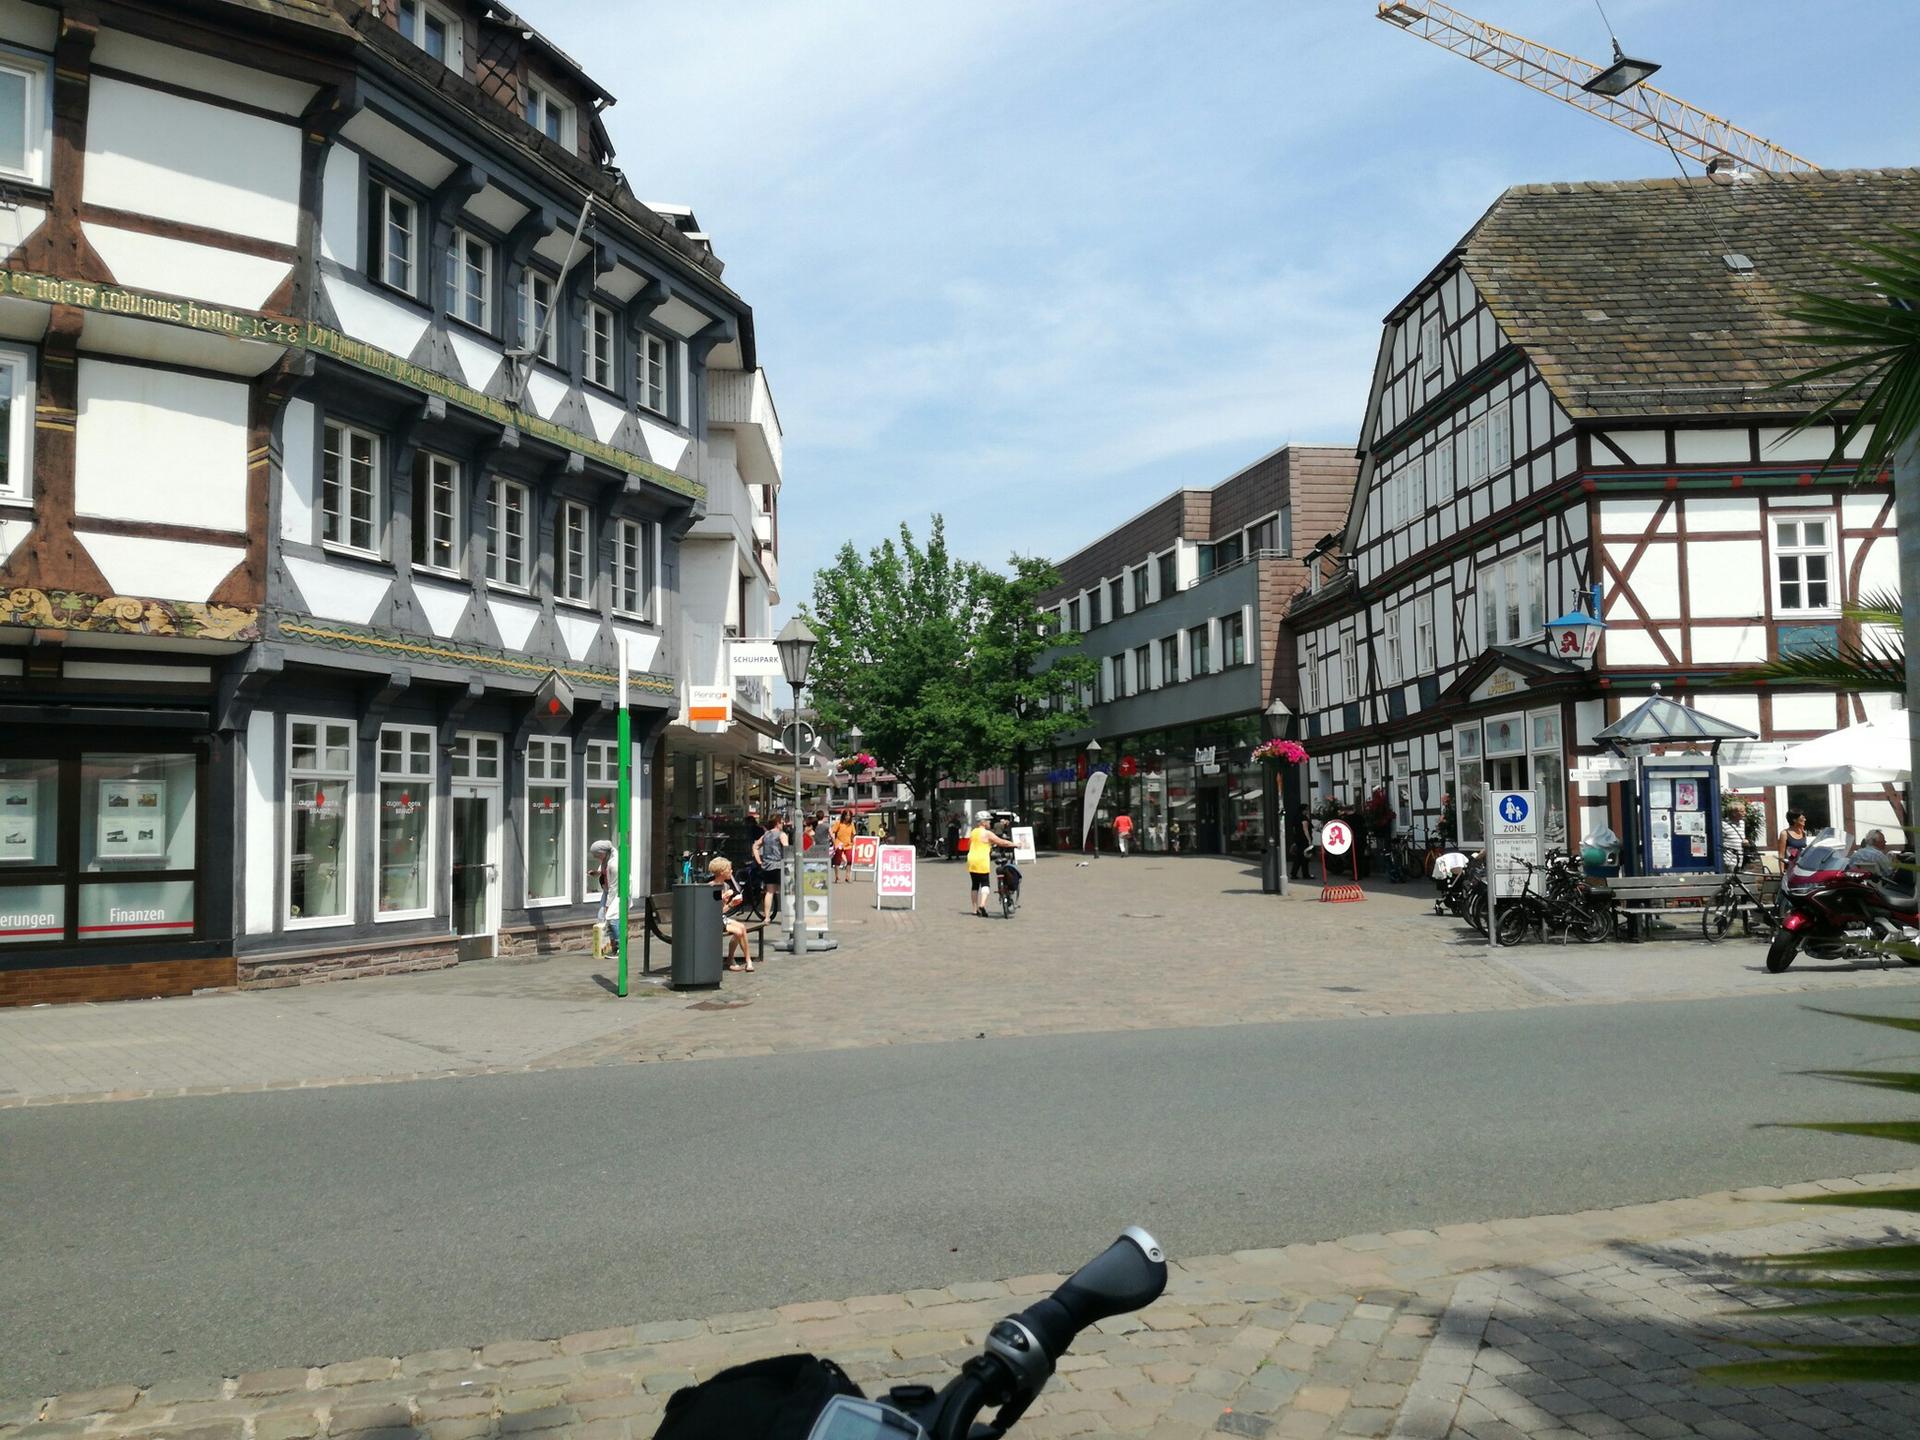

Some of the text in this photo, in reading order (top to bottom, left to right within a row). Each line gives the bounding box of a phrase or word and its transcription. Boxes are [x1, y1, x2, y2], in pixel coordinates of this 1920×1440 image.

[1504, 825, 1526, 833] ZONE
[883, 863, 911, 872] ALLES
[883, 875, 912, 888] 20%
[110, 908, 165, 922] Finanzen
